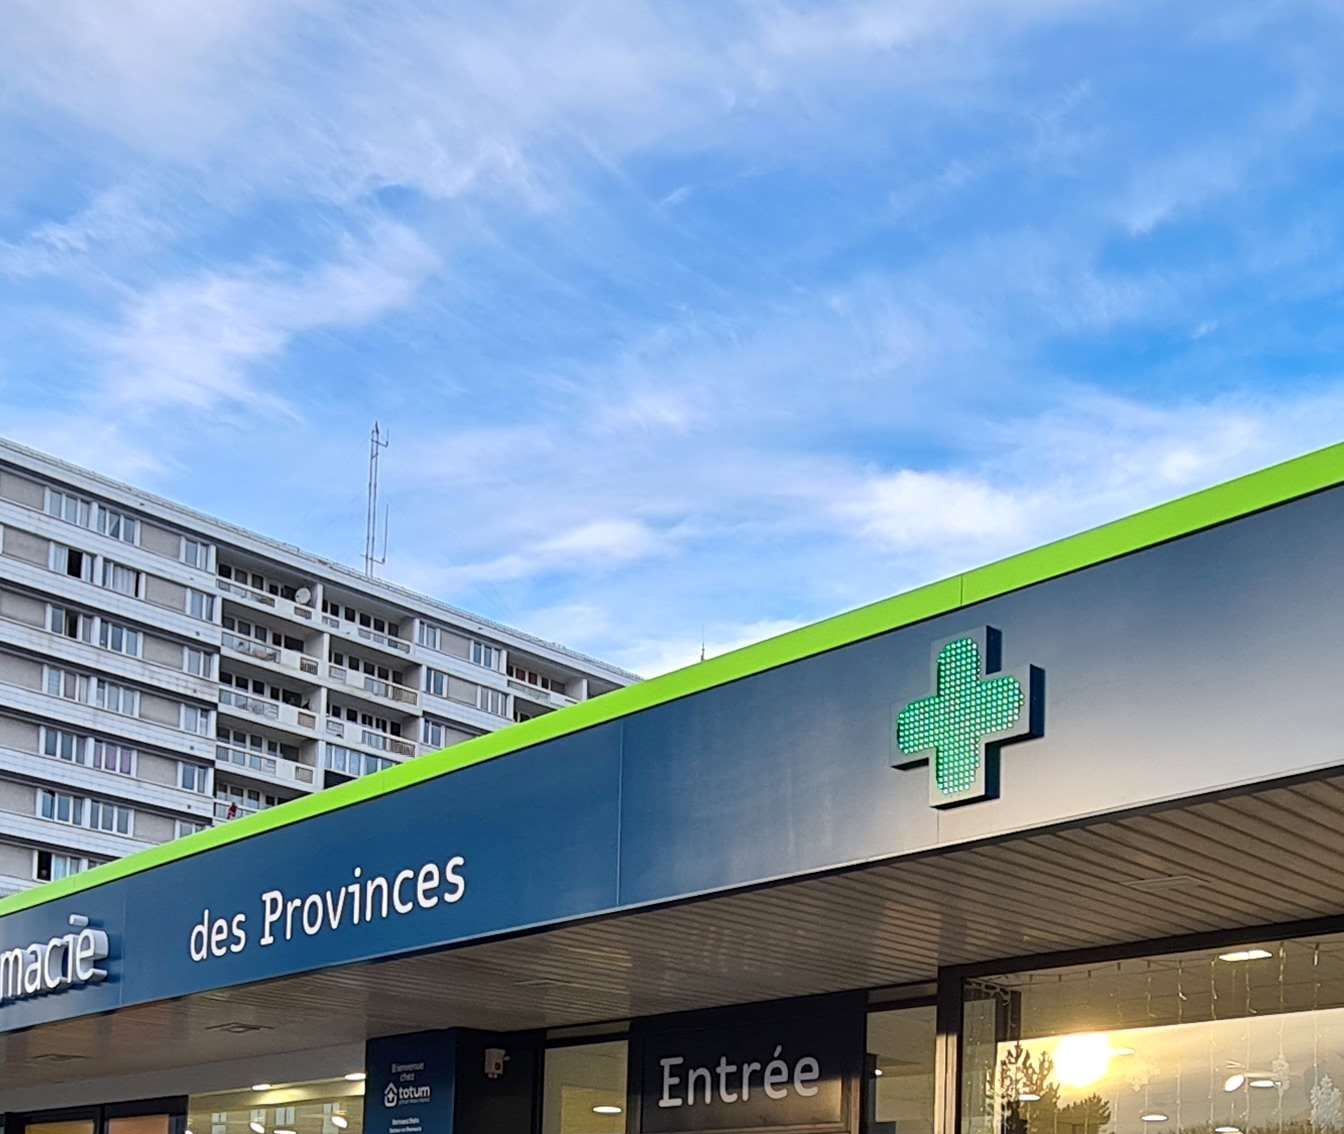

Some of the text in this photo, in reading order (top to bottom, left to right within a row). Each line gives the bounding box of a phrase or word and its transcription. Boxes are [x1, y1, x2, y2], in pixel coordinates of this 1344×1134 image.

[190, 855, 466, 962] des Provinces
[398, 1085, 431, 1099] totum
[658, 1044, 820, 1108] Entrée
